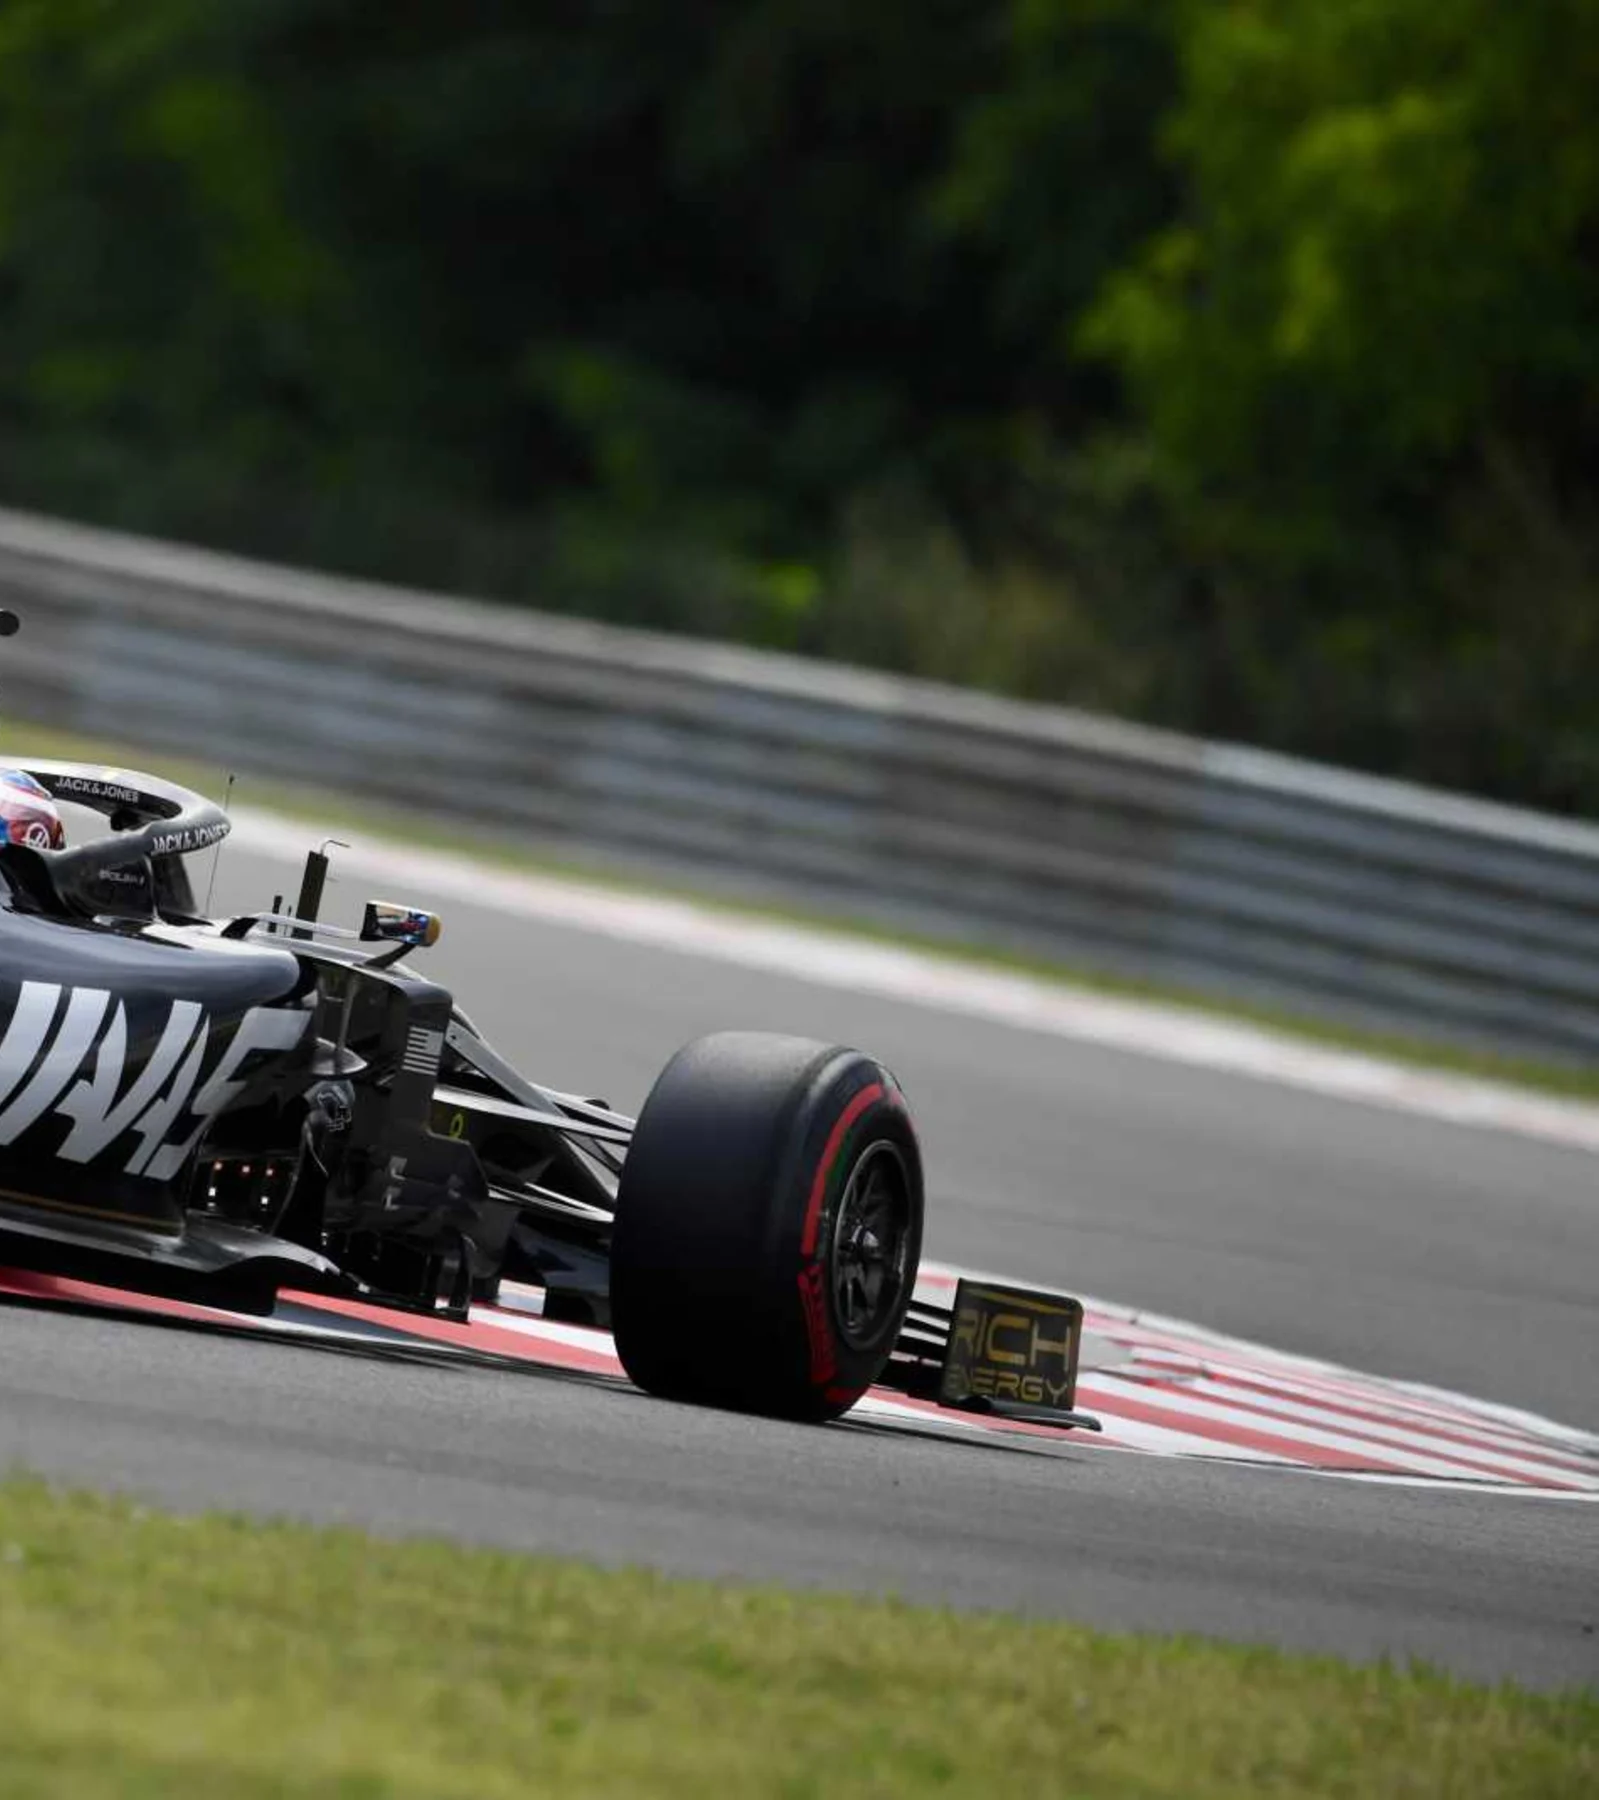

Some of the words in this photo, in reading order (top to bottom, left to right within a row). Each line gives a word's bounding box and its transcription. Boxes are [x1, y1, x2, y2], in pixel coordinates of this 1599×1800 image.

[55, 776, 140, 804] JACK&JONES
[953, 1307, 1072, 1373] RICH
[945, 1363, 1068, 1406] ENERGY
